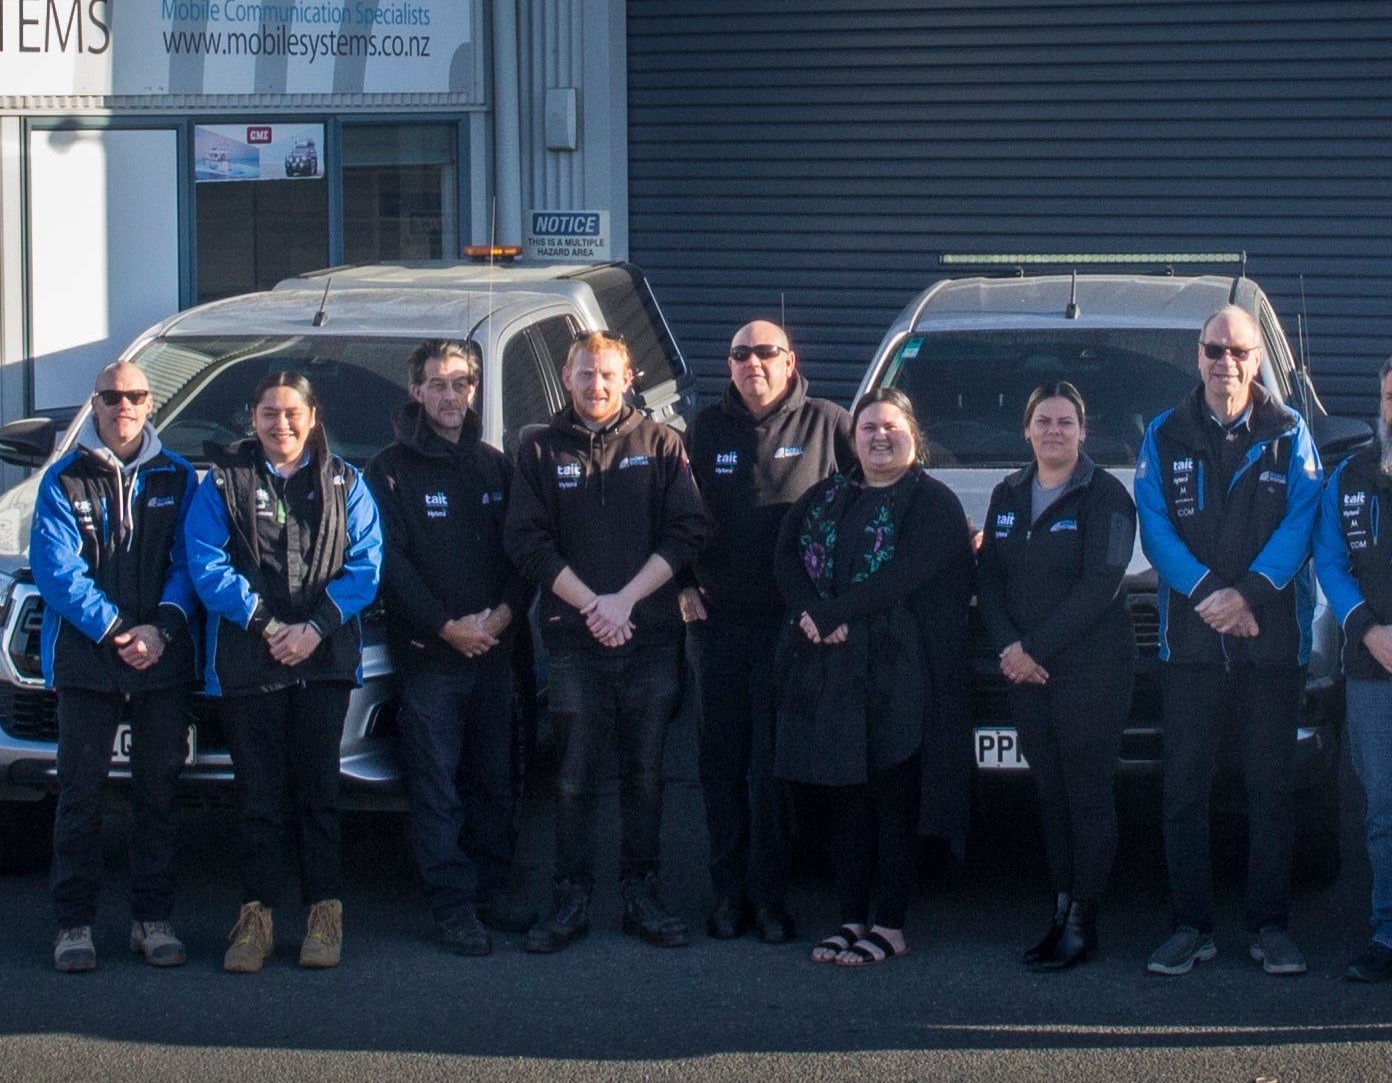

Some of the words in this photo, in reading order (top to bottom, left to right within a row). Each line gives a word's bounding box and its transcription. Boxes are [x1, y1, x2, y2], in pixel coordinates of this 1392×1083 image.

[355, 1, 431, 27] Specialists
[162, 25, 431, 64] www.mobilesystems.co.nz
[249, 130, 269, 141] GME
[536, 216, 597, 233] NOTICE
[528, 238, 546, 247] THIS
[547, 238, 555, 247] IS
[557, 238, 563, 247] A
[565, 238, 605, 247] MULTIPLE
[537, 248, 570, 257] HAZARD
[571, 248, 594, 257] AREA
[557, 463, 581, 476] tait
[425, 491, 448, 505] tait
